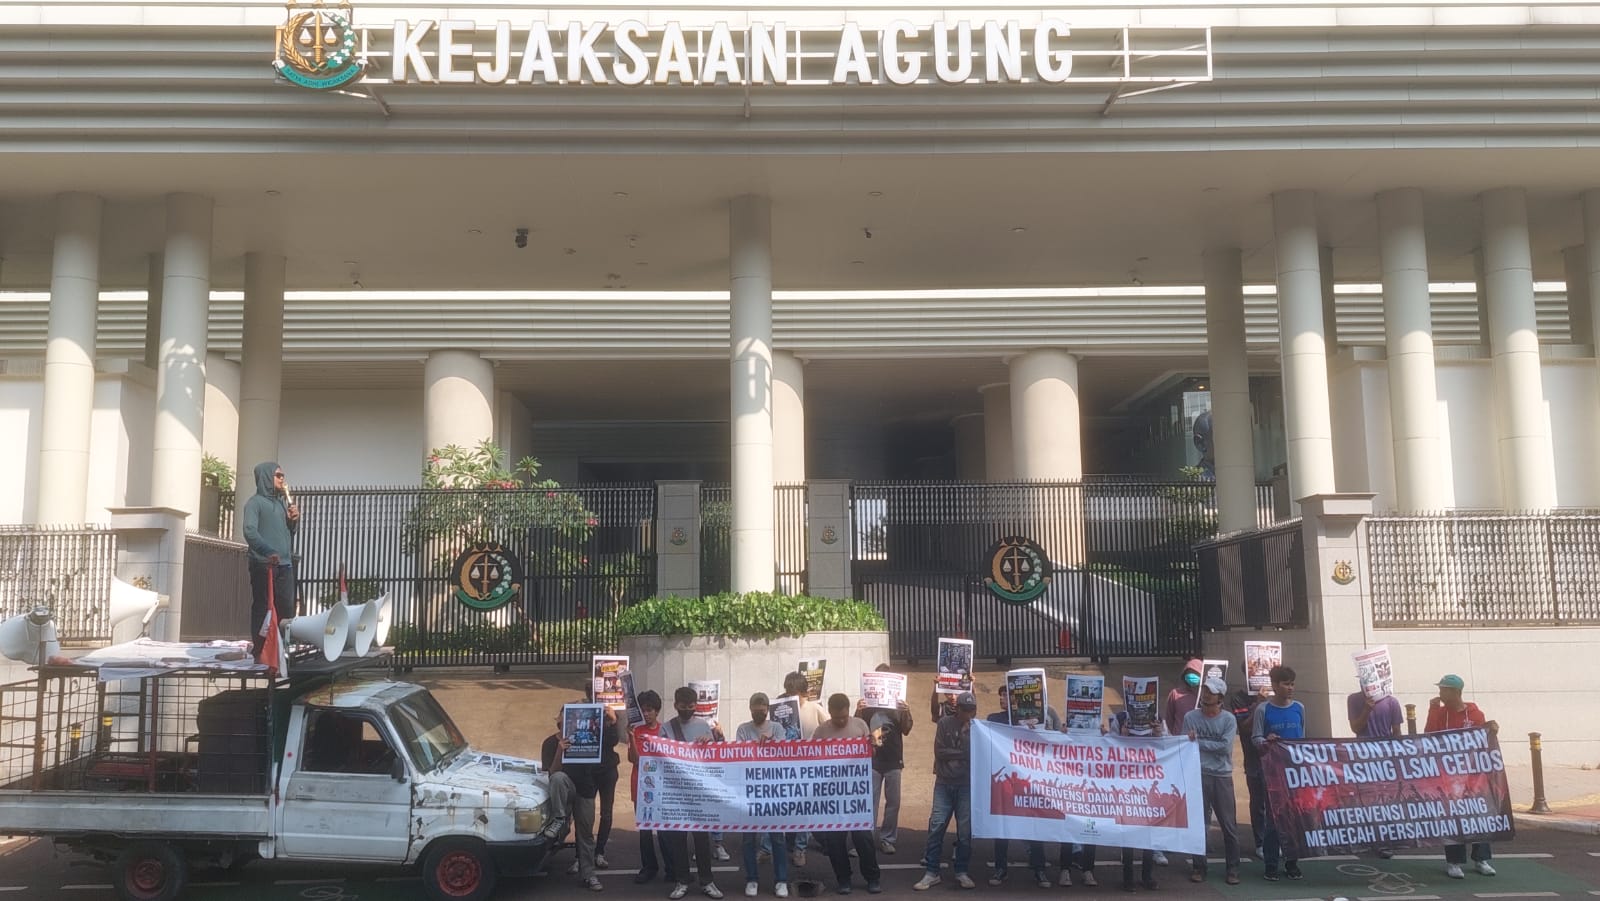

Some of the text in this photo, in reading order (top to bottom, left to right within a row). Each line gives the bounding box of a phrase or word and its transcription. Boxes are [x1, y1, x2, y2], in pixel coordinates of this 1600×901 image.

[392, 18, 1073, 85] KEJAKSAAN AGUNG
[642, 742, 869, 760] SUARA RAKYAT UNTUK KEDAULATAN NEGARA!
[1013, 738, 1157, 764] USUT TUNTAS ALIRAN
[1288, 728, 1490, 765] USUT TUNTAS ALIRAN
[745, 764, 869, 781] MEMINTA PEMERINTAH
[1009, 752, 1165, 780] DANA ASING LSM CELIOS
[1285, 749, 1504, 790] DANA ASING LSM CELIOS
[746, 783, 809, 799] PERKETAT
[812, 780, 870, 797] REGULASI
[1029, 783, 1148, 806] INTERVENSI DANA ASING
[747, 800, 872, 817] TRANSPARANSI LSM.
[1014, 795, 1167, 818] MEMECAH PERSATUAN BANGSA
[1323, 797, 1488, 827] INTERVENSI DANA ASING
[1305, 814, 1512, 849] MEMECAH PERSATUAN BANGSA
